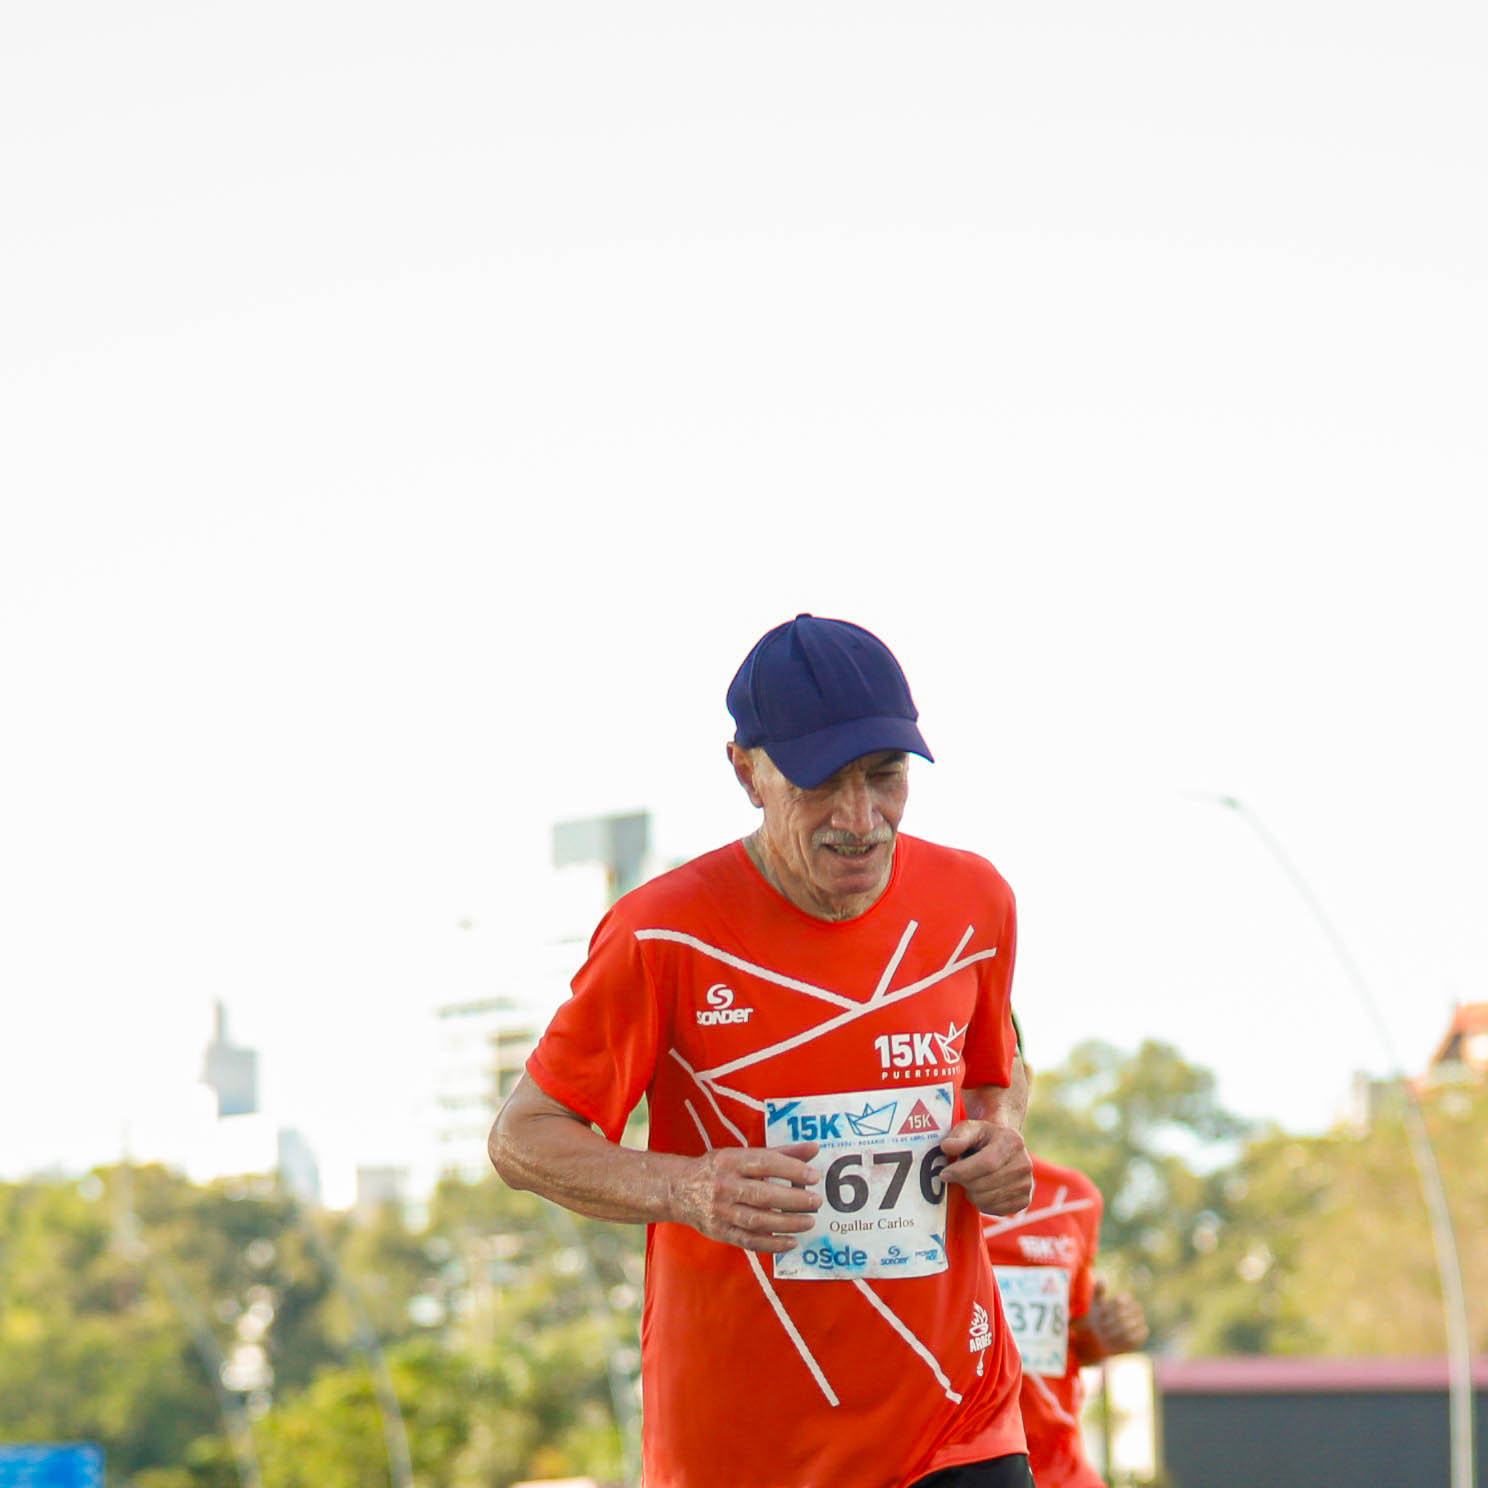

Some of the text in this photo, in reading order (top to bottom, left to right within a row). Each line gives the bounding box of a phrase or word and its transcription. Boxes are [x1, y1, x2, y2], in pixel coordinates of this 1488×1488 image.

[874, 1032, 938, 1069] 15K
[787, 1113, 842, 1142] 15K
[908, 1114, 932, 1130] 15K
[829, 1216, 915, 1235] Ogallar Carlos
[802, 1245, 868, 1269] osde
